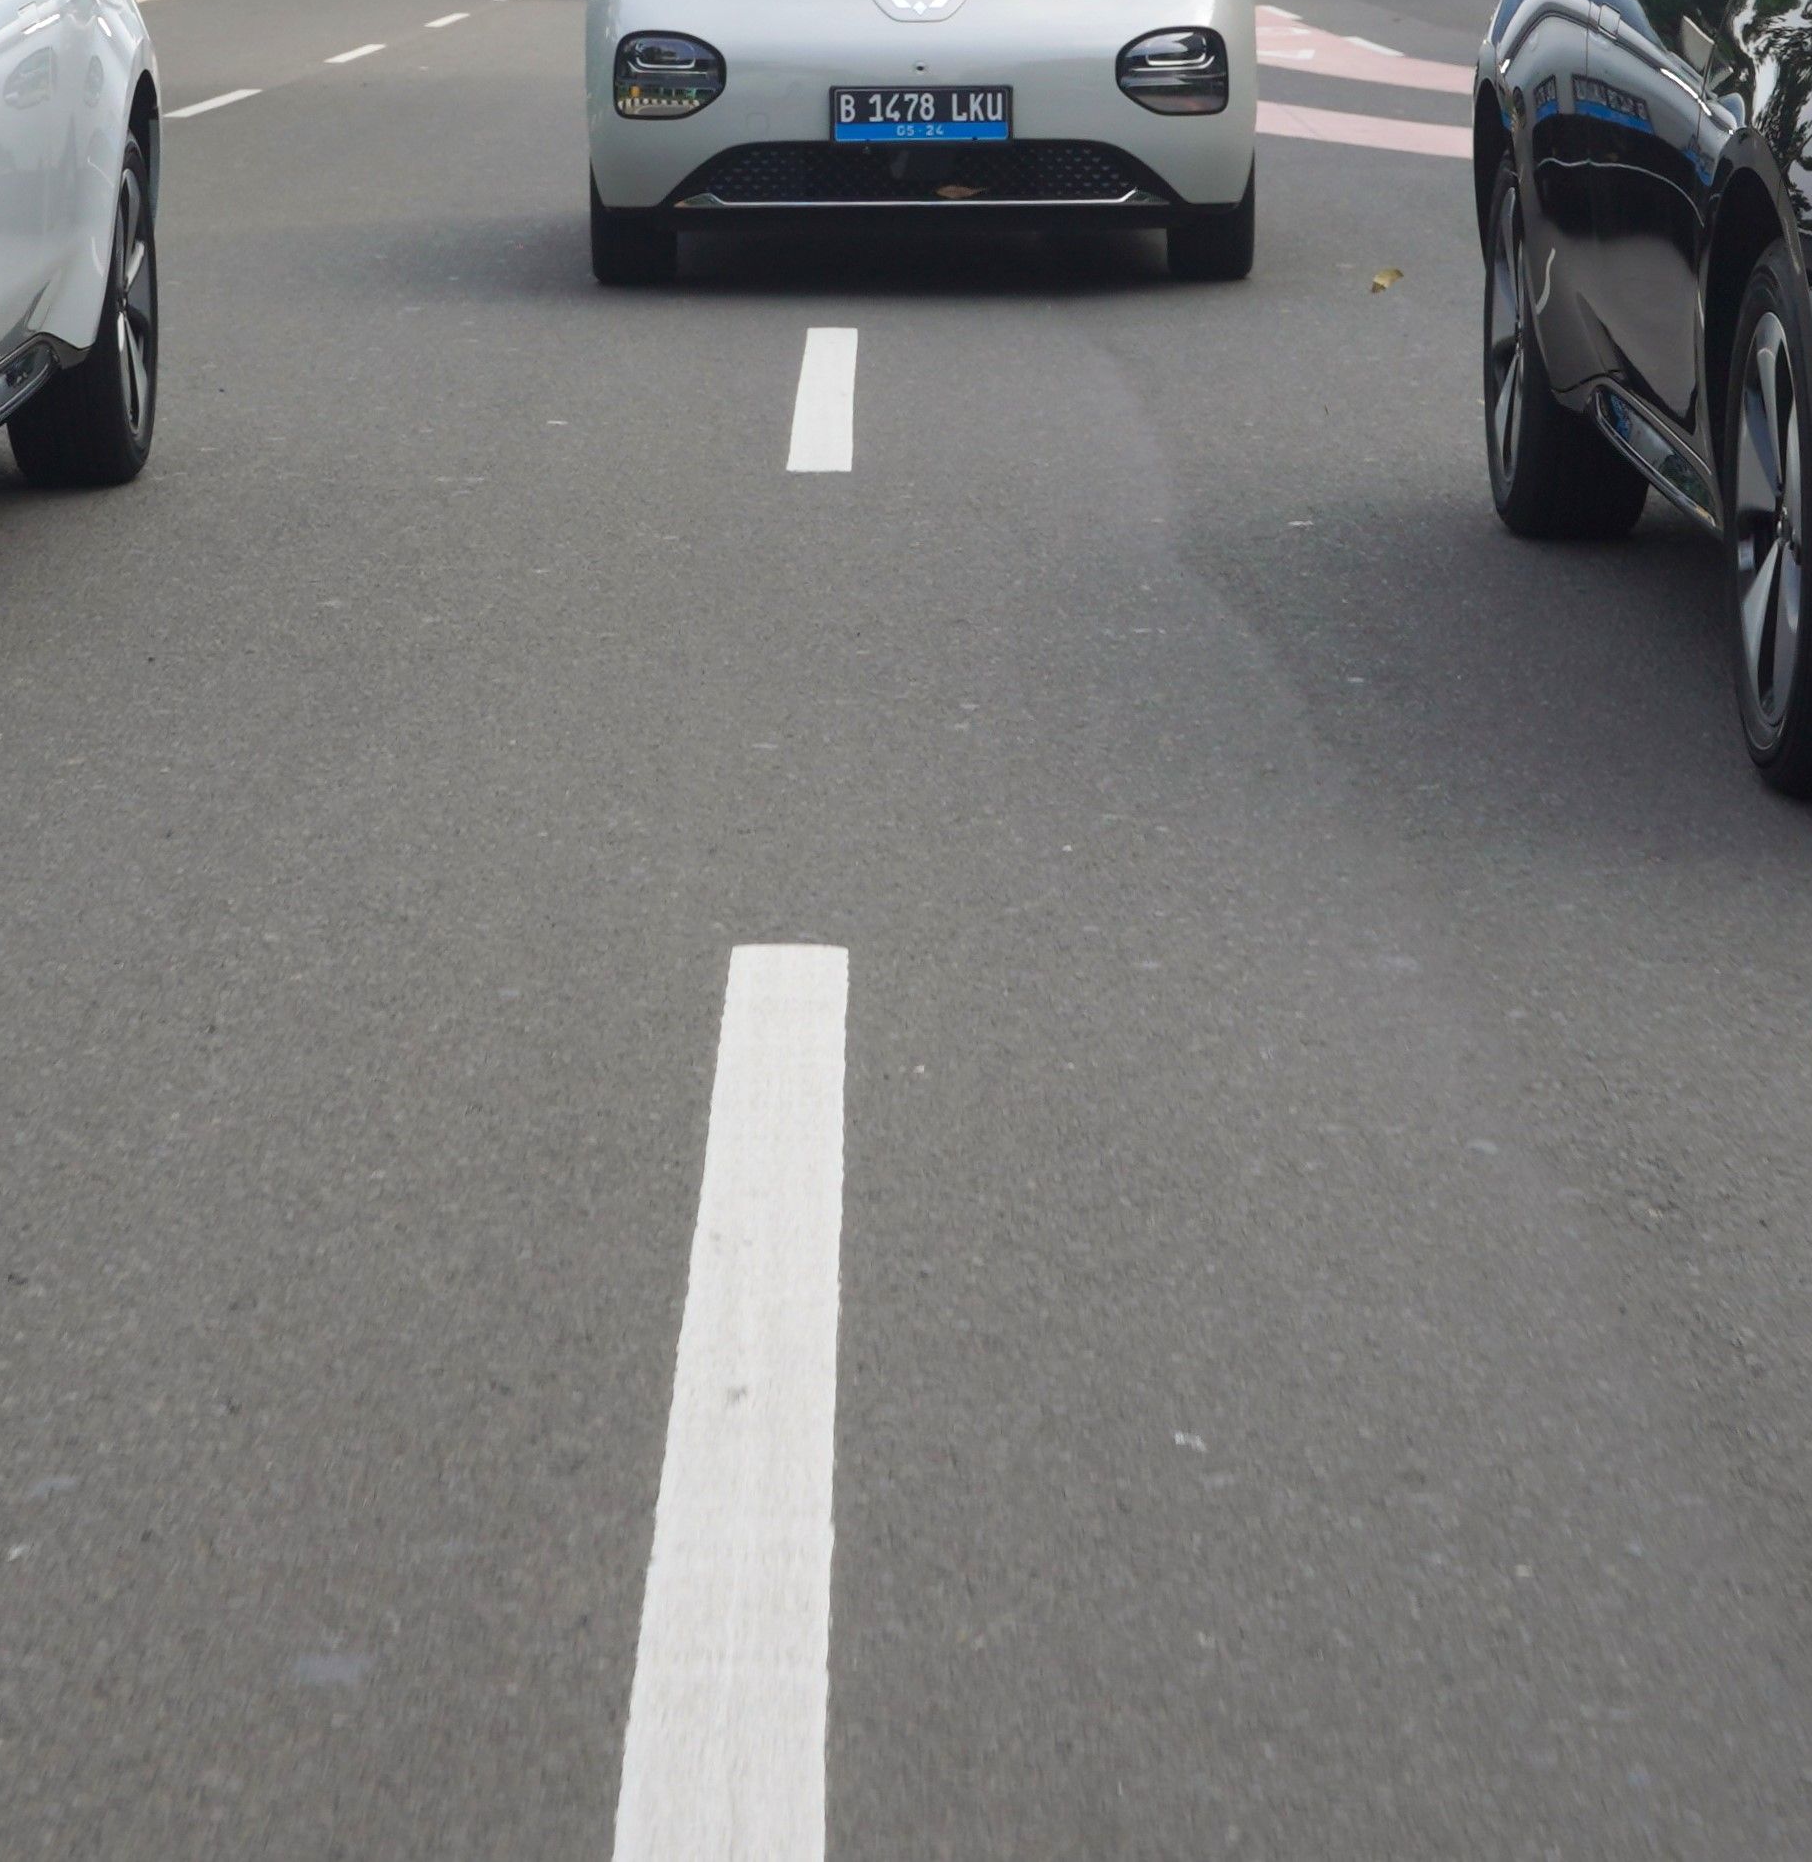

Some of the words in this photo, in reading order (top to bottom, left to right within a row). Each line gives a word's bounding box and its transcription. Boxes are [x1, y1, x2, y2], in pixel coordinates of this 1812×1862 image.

[840, 94, 856, 123] B
[868, 93, 935, 122] 1478
[951, 93, 1003, 122] LKU
